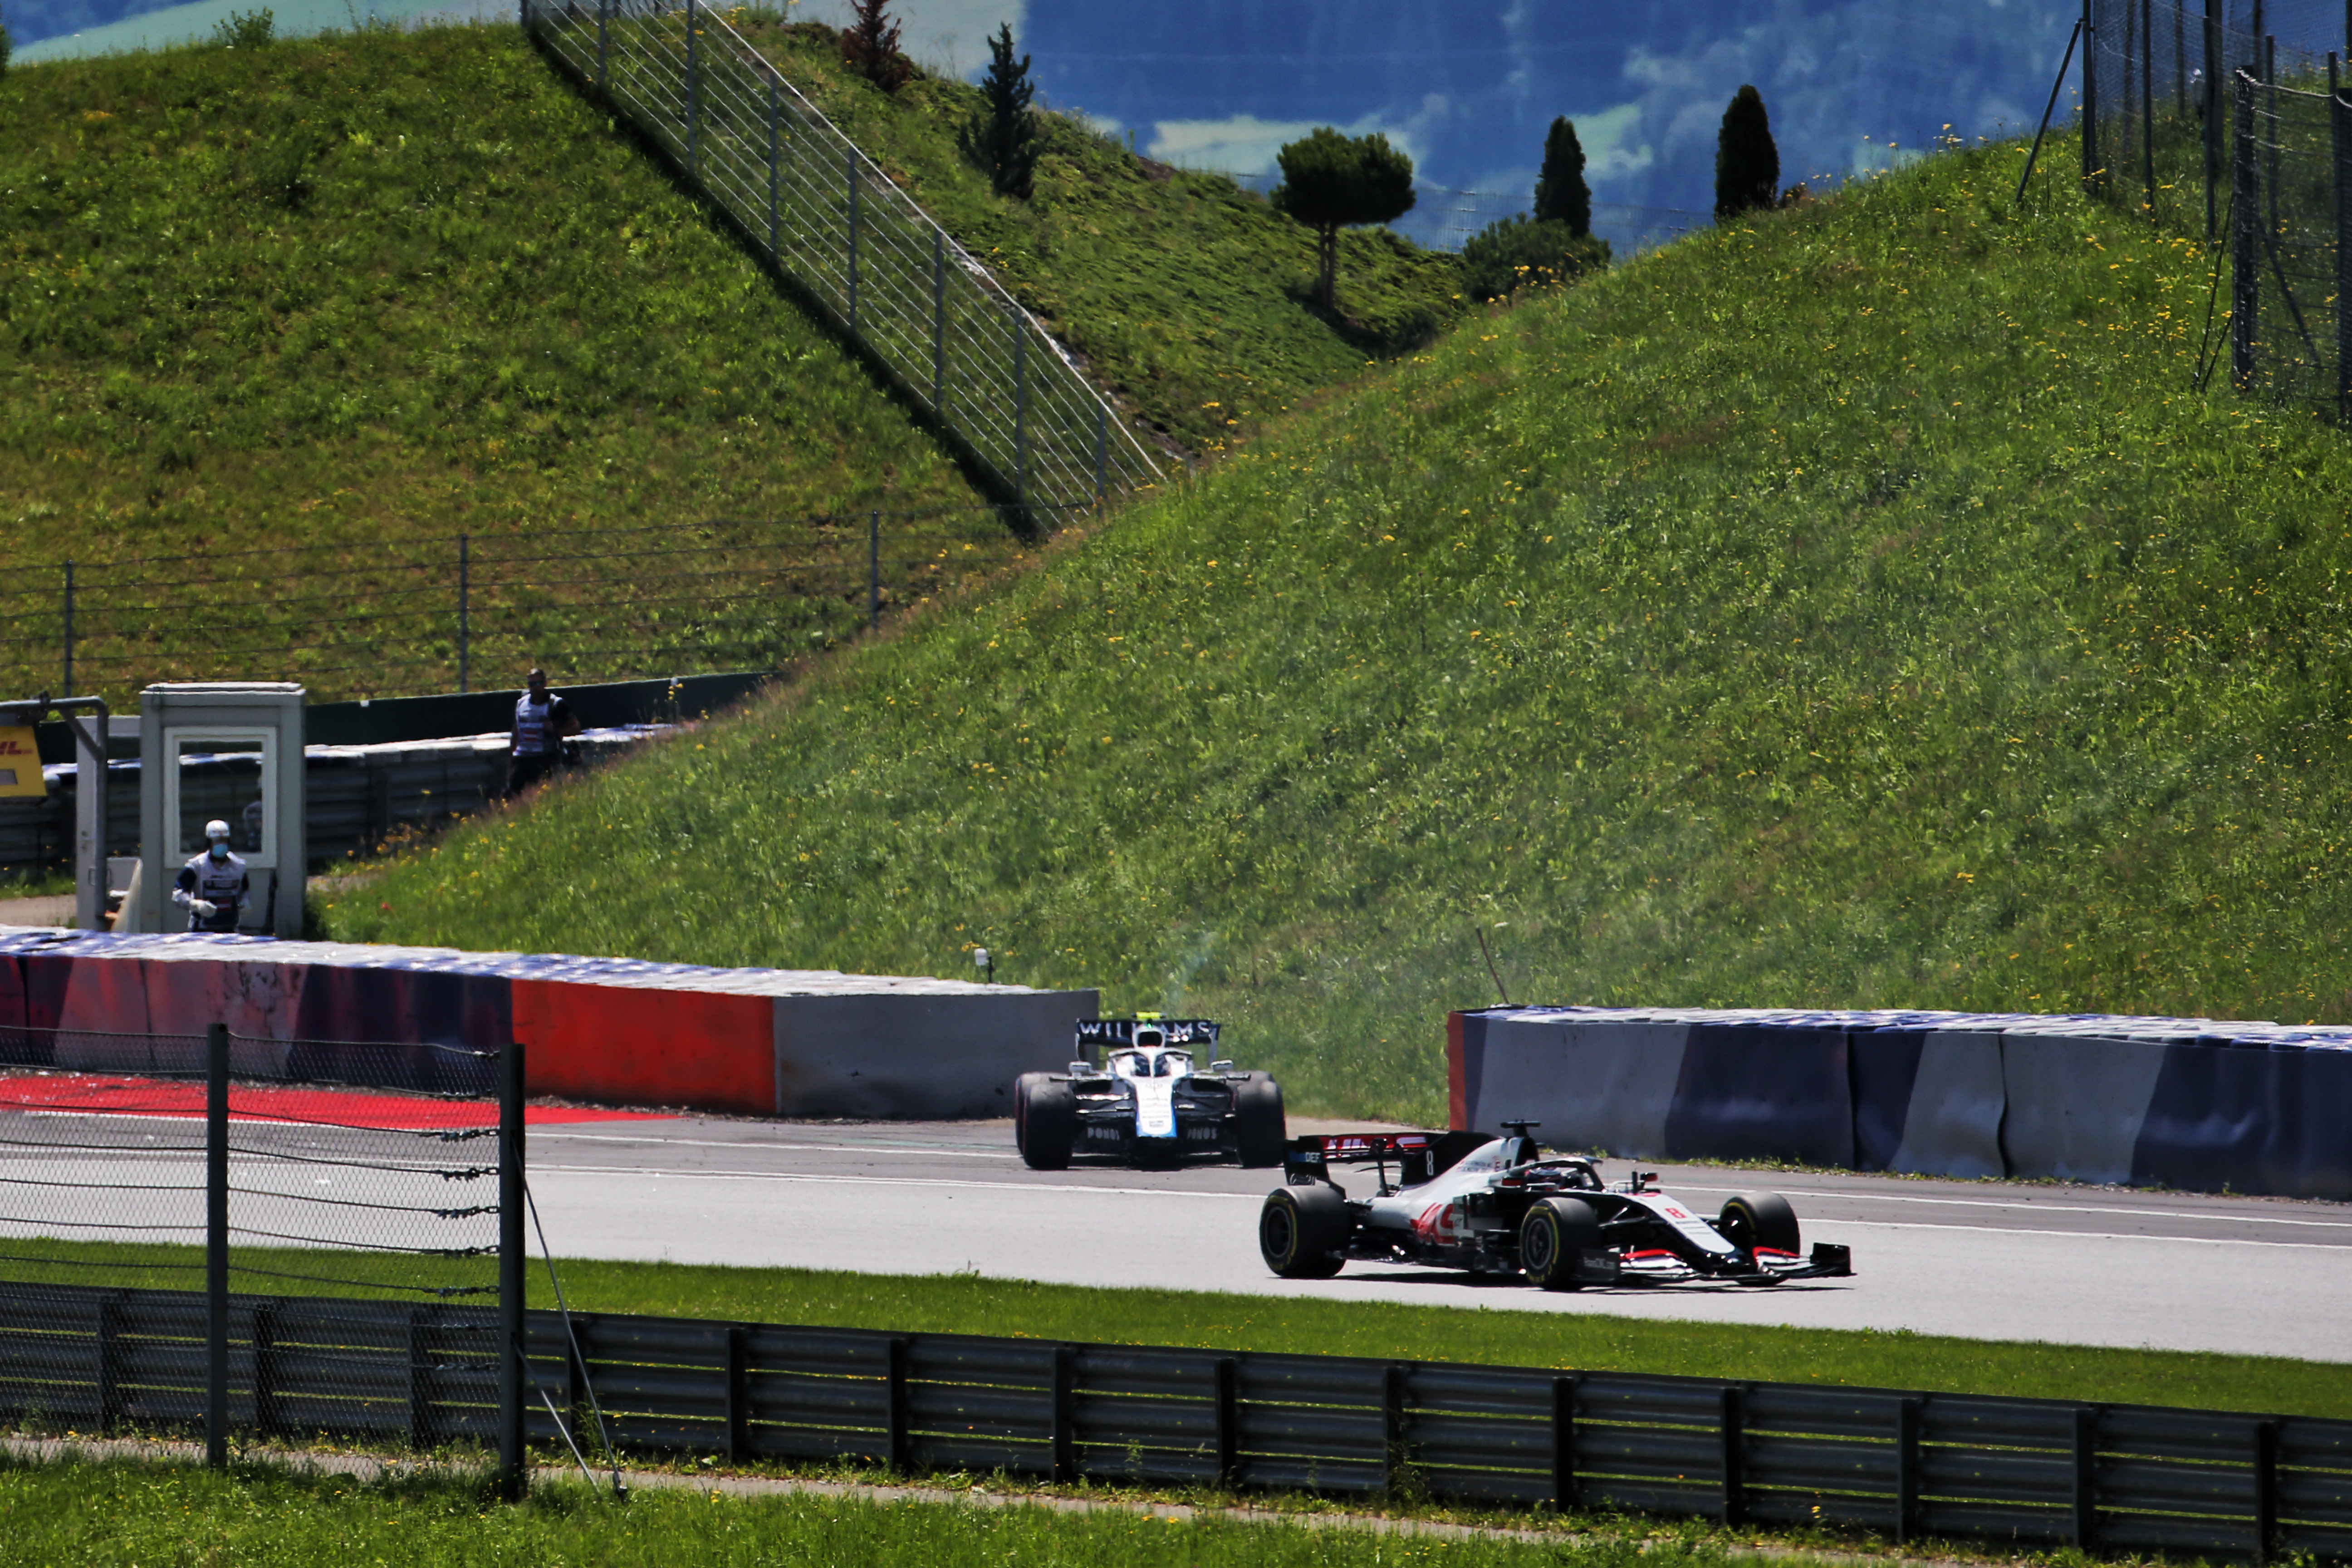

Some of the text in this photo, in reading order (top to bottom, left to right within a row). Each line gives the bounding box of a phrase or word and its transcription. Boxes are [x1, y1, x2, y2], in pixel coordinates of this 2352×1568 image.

[1079, 1022, 1210, 1038] WILAMS
[1426, 1150, 1434, 1176] 8
[1664, 1207, 1687, 1219] 8
